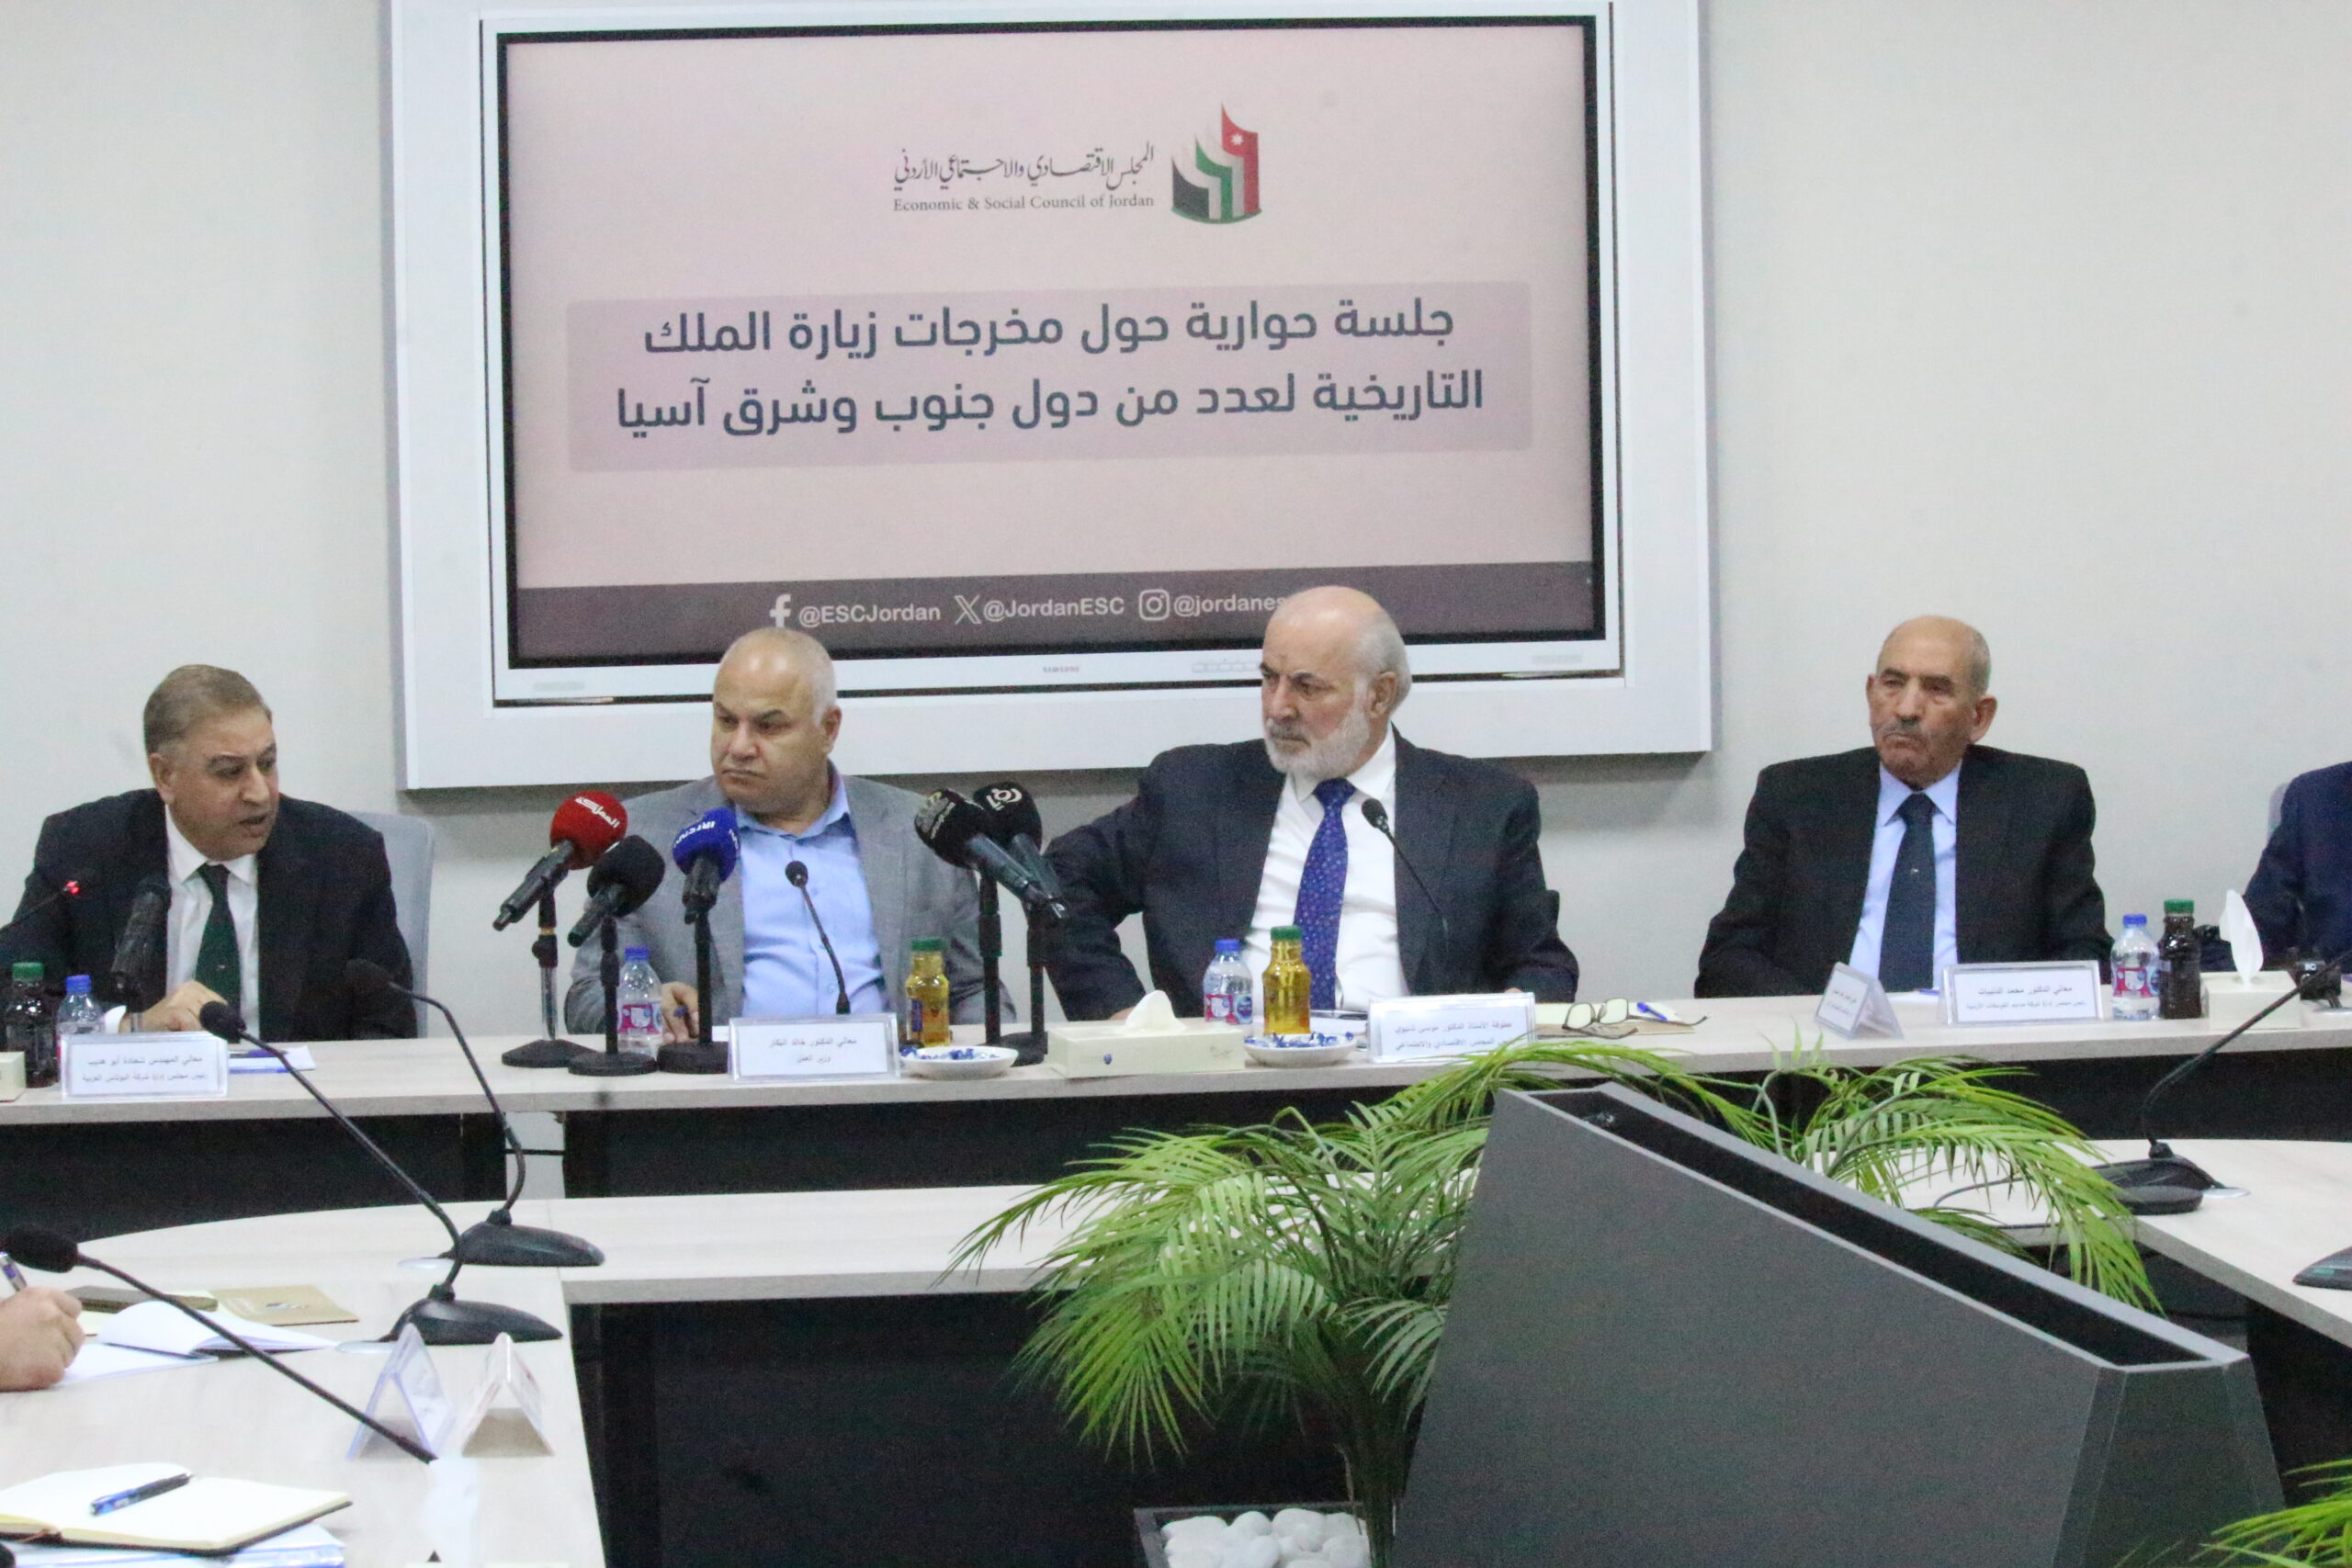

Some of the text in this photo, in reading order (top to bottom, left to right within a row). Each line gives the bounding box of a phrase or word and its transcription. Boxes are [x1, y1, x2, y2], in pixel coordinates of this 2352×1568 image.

[939, 153, 1025, 190] والاجتماعي
[1027, 146, 1114, 186] الاقتصادي
[1105, 140, 1155, 191] المجلس
[893, 193, 1155, 211] Economic & Social Council of Jordan
[644, 297, 1453, 360] جلسة حوارية حول مخرجات زيارة الملك
[617, 368, 1483, 438] التاريخية لعدد من دول جنوب وشرق آسيا
[797, 603, 941, 628] @ESCJordan
[982, 596, 1125, 622] @JordanESC
